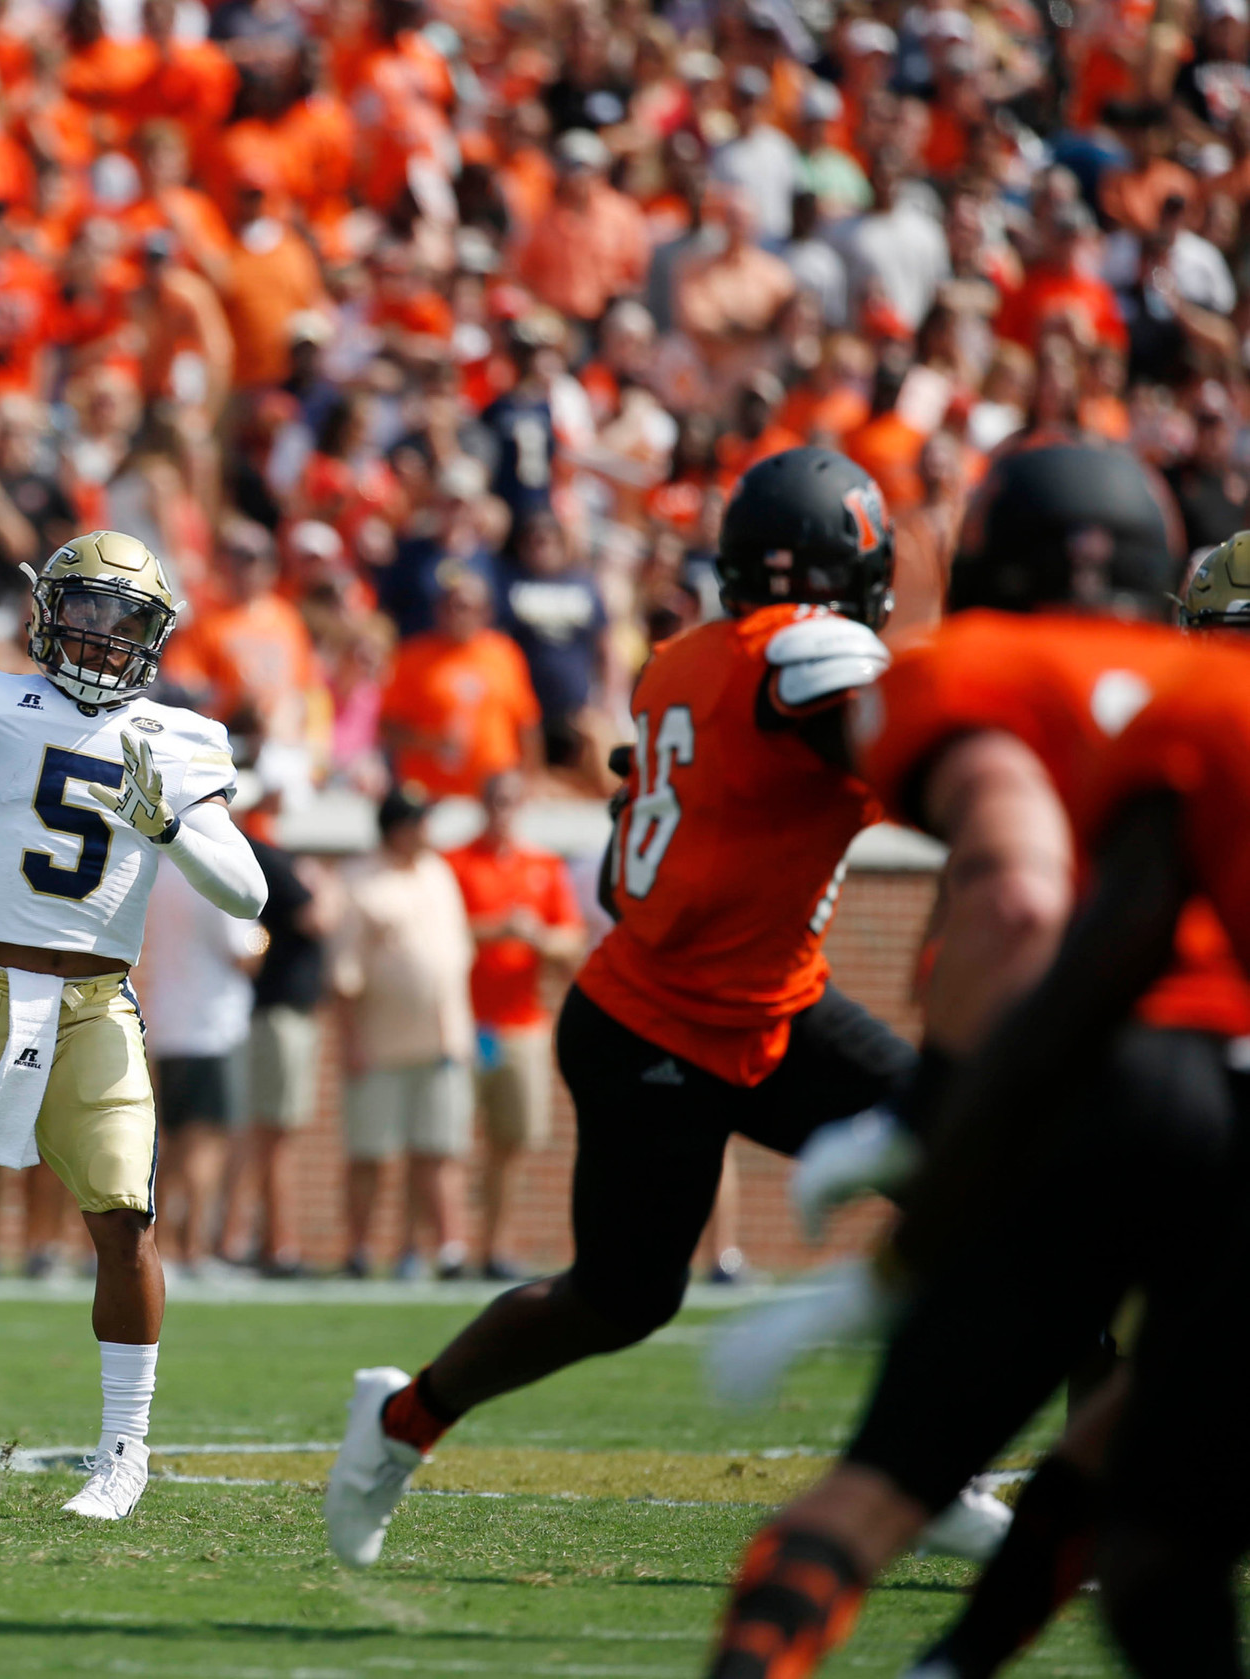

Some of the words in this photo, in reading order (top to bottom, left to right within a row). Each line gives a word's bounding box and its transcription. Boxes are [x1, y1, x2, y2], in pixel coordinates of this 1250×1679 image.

[107, 576, 133, 588] ACC
[22, 693, 43, 705] R
[17, 702, 45, 711] RUSSELL
[134, 718, 162, 732] ACC
[19, 743, 126, 903] 5
[19, 1047, 39, 1062] R
[13, 1059, 42, 1070] RUSSELL
